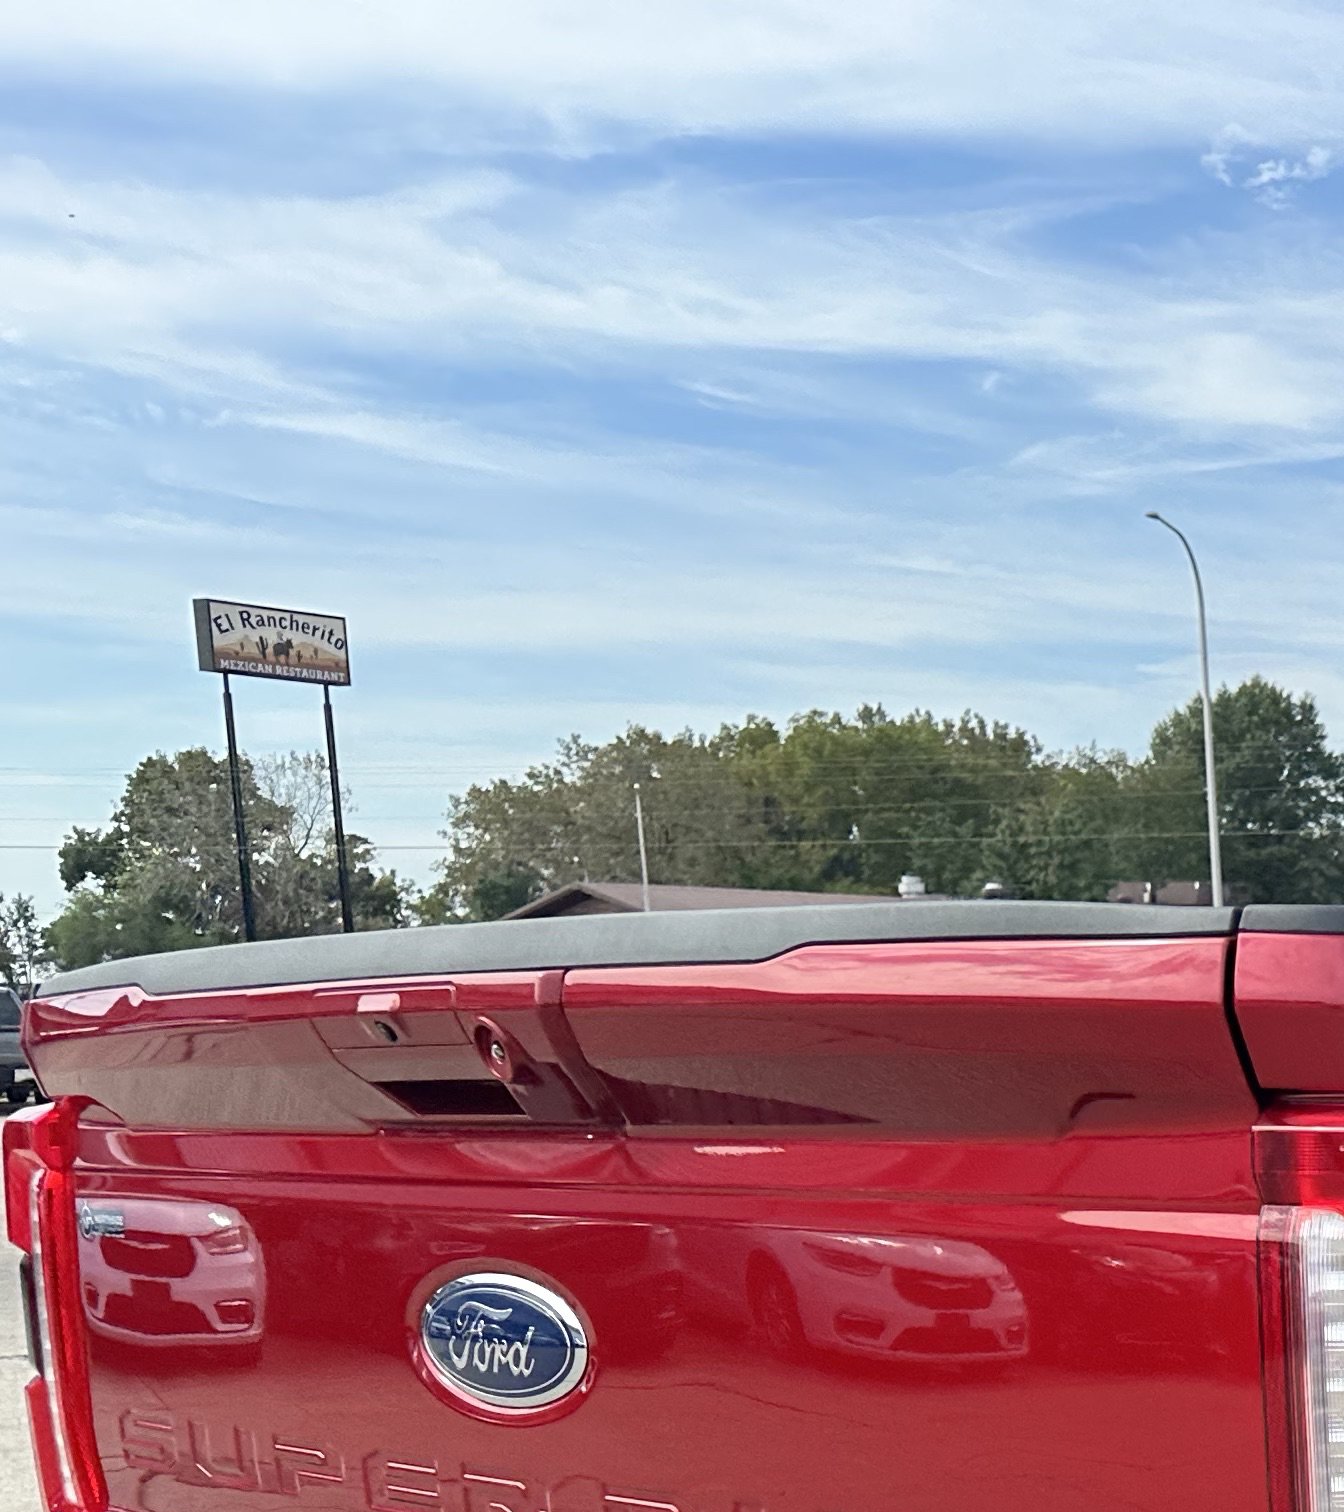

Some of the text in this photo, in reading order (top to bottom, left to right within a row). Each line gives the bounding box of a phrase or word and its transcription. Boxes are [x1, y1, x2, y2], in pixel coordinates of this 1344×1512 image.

[212, 611, 345, 650] El Rancherito
[220, 659, 345, 682] MEXICAN RESTAURANT
[448, 1301, 536, 1377] Ford
